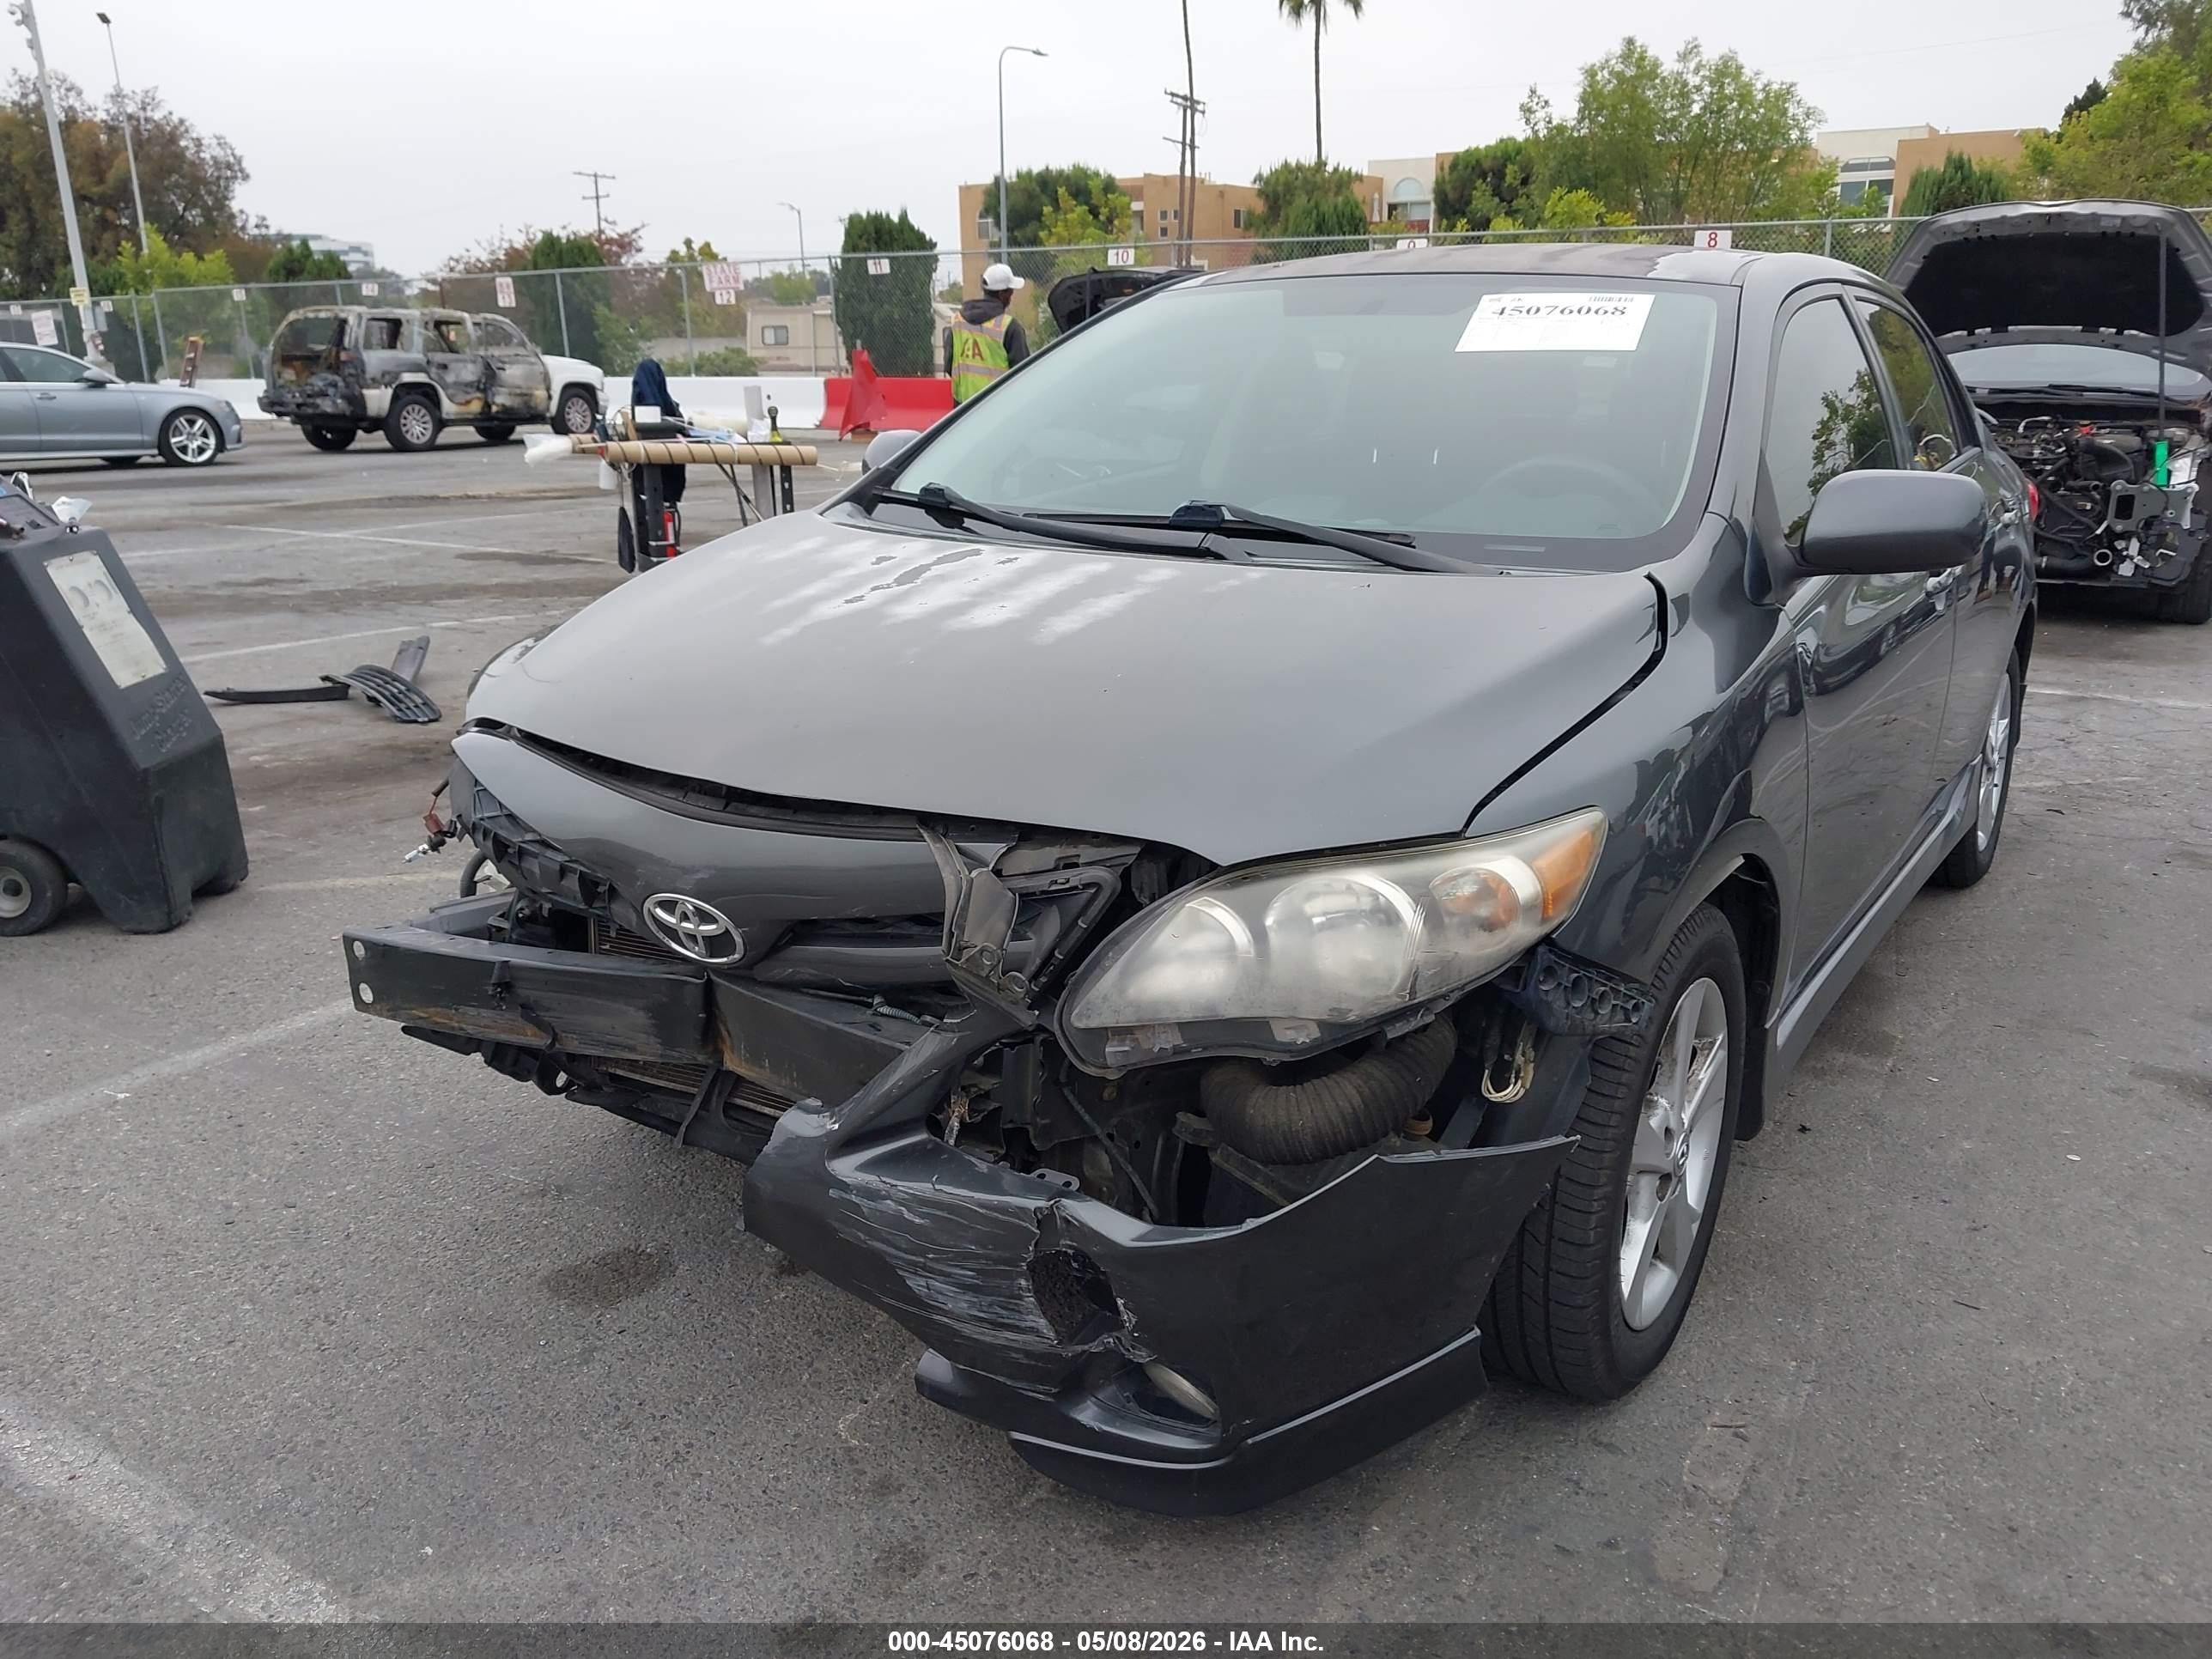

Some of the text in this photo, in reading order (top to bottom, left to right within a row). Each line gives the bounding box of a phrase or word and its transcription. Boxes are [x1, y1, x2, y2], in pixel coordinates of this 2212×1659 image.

[1707, 232, 1717, 248] 8
[1114, 250, 1129, 264] 10
[705, 264, 741, 275] STATE
[873, 260, 883, 273] 11
[708, 275, 740, 287] FARM
[720, 291, 732, 303] 12
[1492, 305, 1627, 316] 45076068
